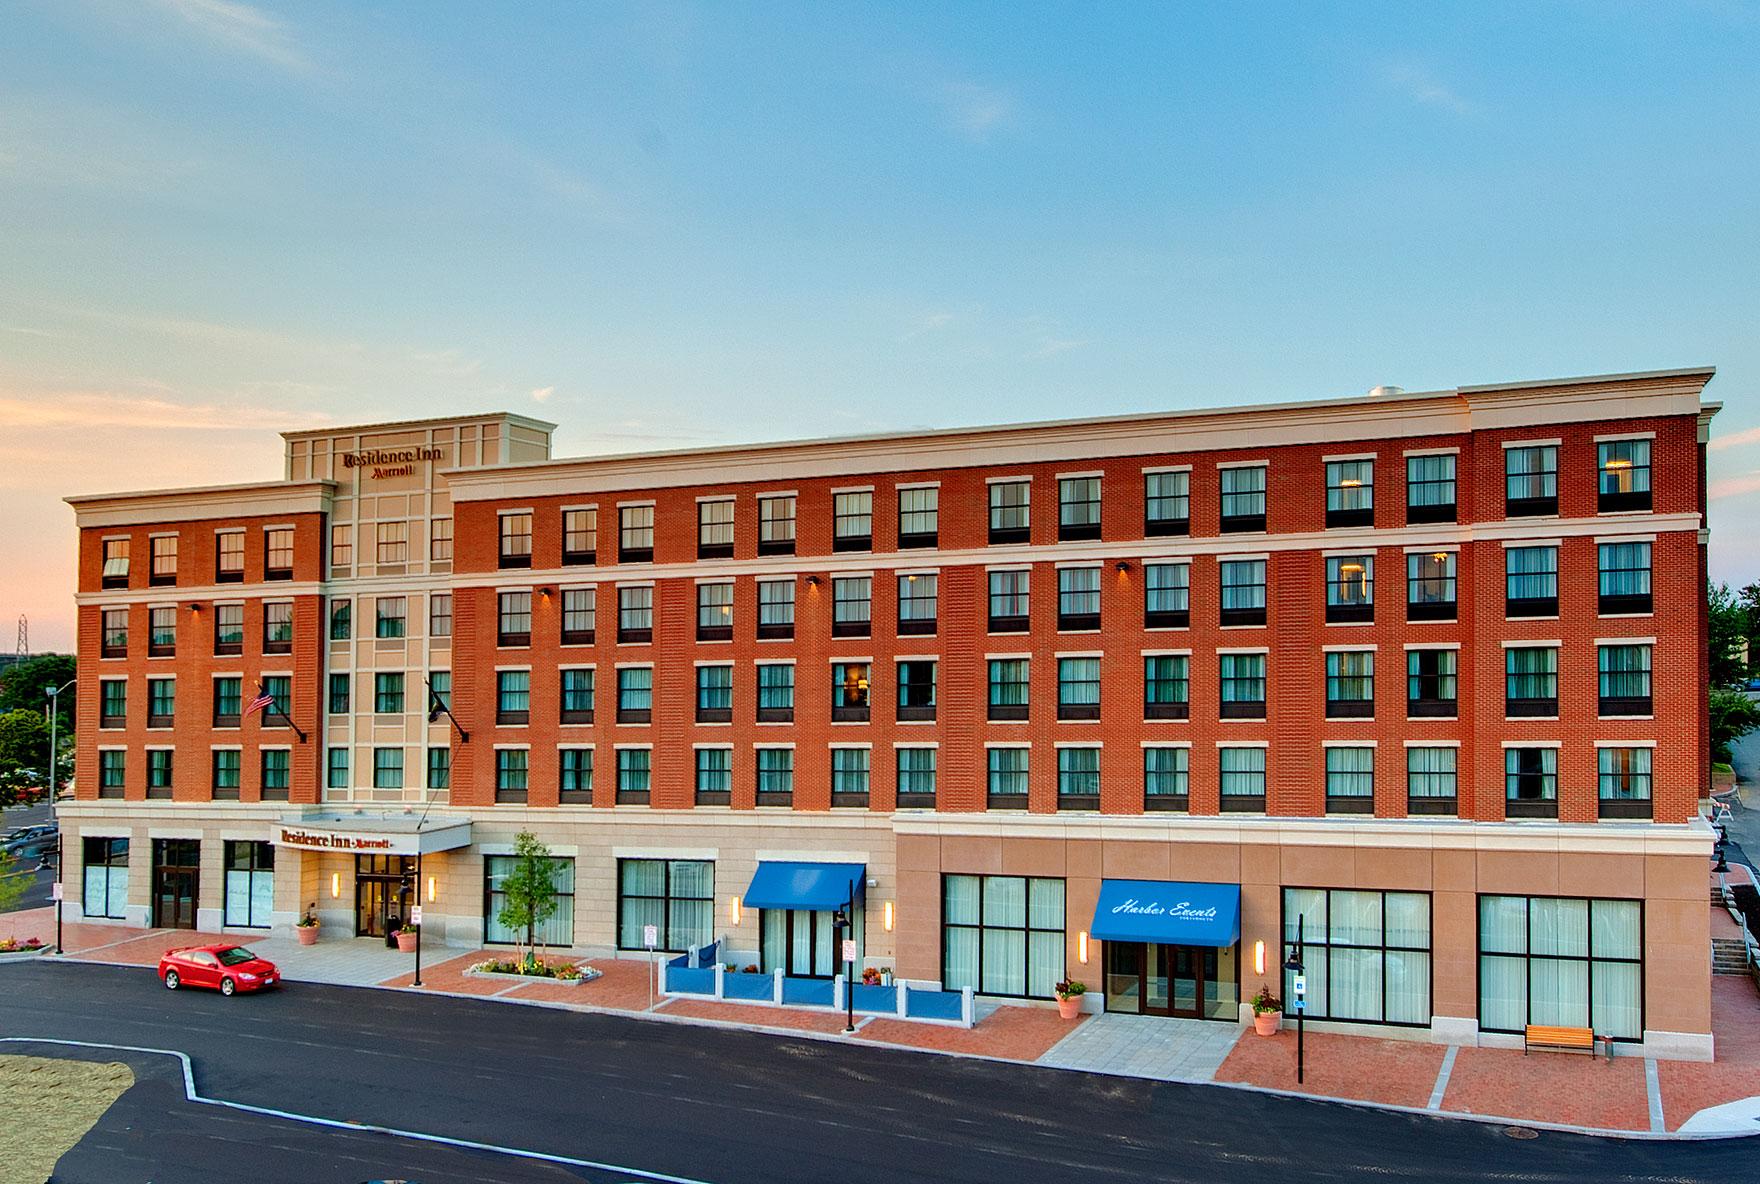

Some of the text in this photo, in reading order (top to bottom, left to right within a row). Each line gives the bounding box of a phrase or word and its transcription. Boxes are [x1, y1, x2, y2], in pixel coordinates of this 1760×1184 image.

[343, 447, 442, 469] Residence Inn
[371, 463, 413, 480] Marriott
[281, 829, 329, 847] Residence
[330, 834, 350, 849] Inn
[1111, 898, 1217, 917] Harbor Events
